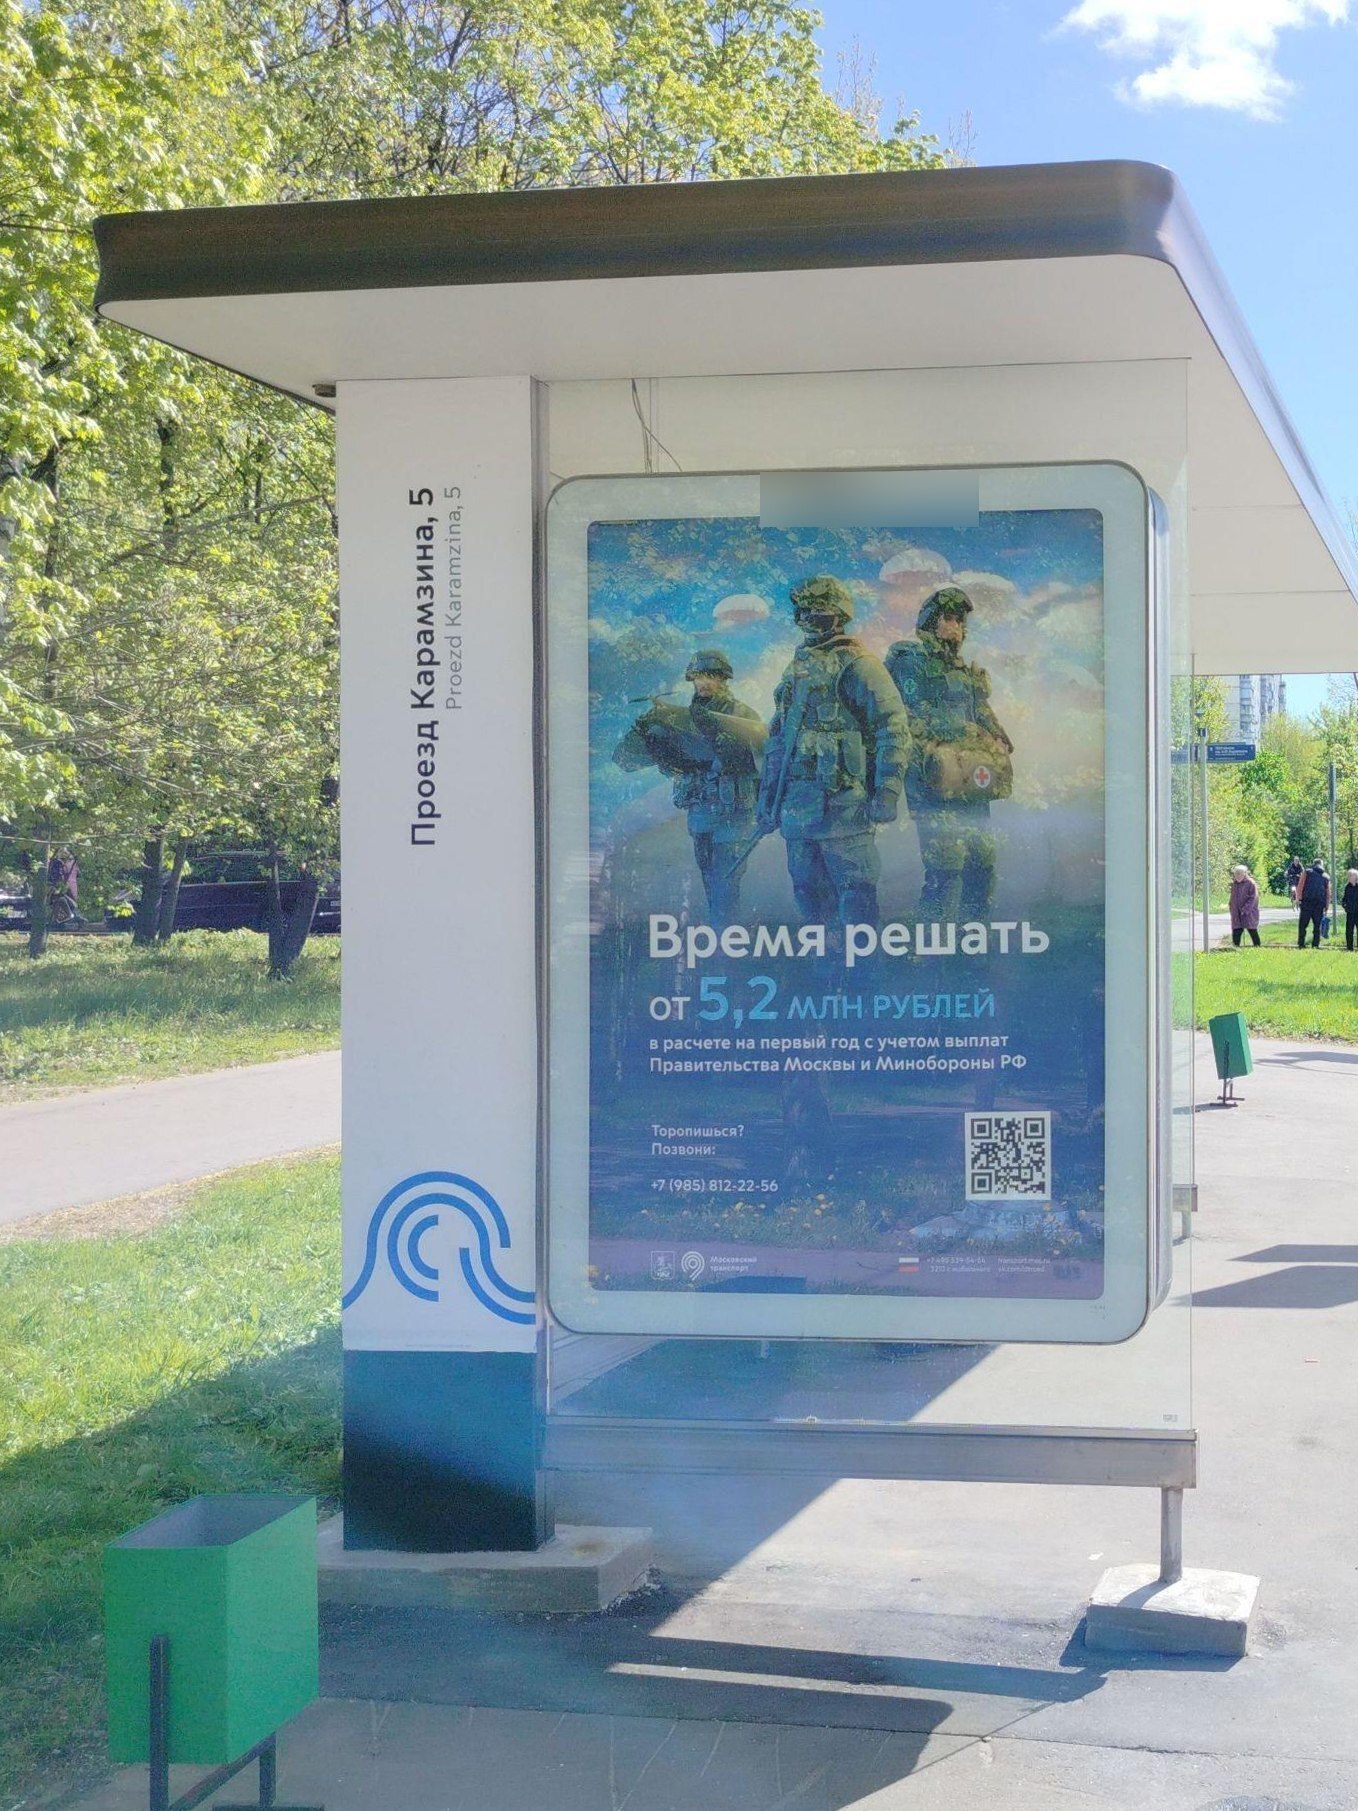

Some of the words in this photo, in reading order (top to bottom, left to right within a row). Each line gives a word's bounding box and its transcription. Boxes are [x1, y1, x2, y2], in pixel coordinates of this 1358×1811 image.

[409, 487, 434, 506] 5
[444, 486, 462, 499] 5
[444, 505, 464, 627] Karamzina,
[409, 515, 441, 710] Карамзина,
[443, 635, 463, 711] Proezd
[410, 720, 442, 846] Проезд
[648, 913, 826, 969] Время
[845, 920, 1051, 968] решать
[648, 995, 691, 1021] от
[697, 975, 779, 1029] 5,2
[786, 993, 863, 1020] МЛН
[872, 987, 996, 1020] РУБЛЕЙ
[650, 1039, 659, 1050] в
[663, 1037, 731, 1053] расчете
[735, 1037, 756, 1050] на
[760, 1034, 827, 1053] первый
[831, 1037, 861, 1051] год
[864, 1037, 874, 1049] с
[877, 1036, 940, 1052] учетом
[944, 1035, 1009, 1049] выплат
[650, 1057, 780, 1075] Правительства
[783, 1057, 856, 1072] Москвы
[860, 1059, 871, 1071] и
[875, 1055, 995, 1073] Минобороны
[1000, 1054, 1028, 1070] РФ
[651, 1124, 745, 1139] Торопишься?
[651, 1142, 716, 1156] Позвони:
[650, 1179, 666, 1191] +7
[669, 1178, 706, 1192] (985)
[708, 1179, 779, 1192] 812-22-56
[709, 1255, 758, 1264] Московский
[709, 1265, 750, 1274] транспорт
